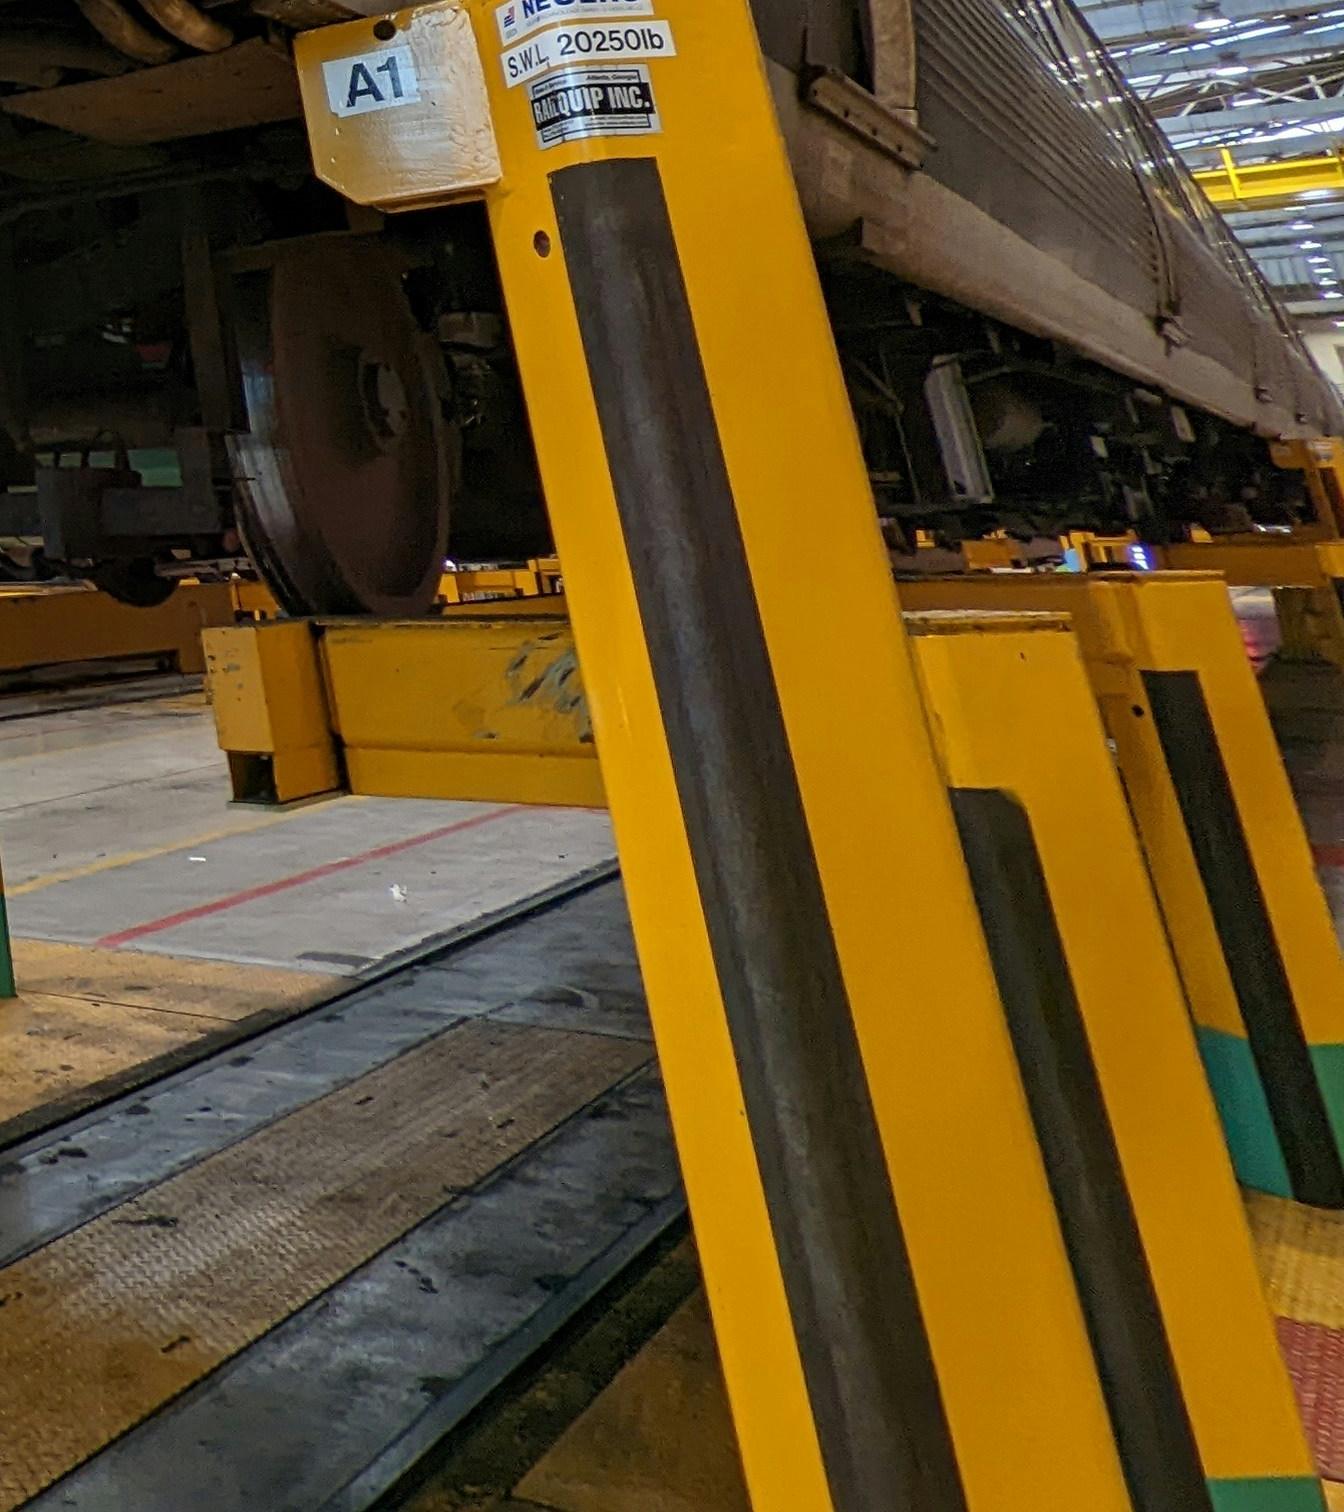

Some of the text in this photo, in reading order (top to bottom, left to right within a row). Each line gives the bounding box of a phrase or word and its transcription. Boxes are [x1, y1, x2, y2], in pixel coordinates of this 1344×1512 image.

[556, 28, 664, 56] 20250lb
[345, 55, 404, 108] A1
[607, 86, 651, 109] INC.
